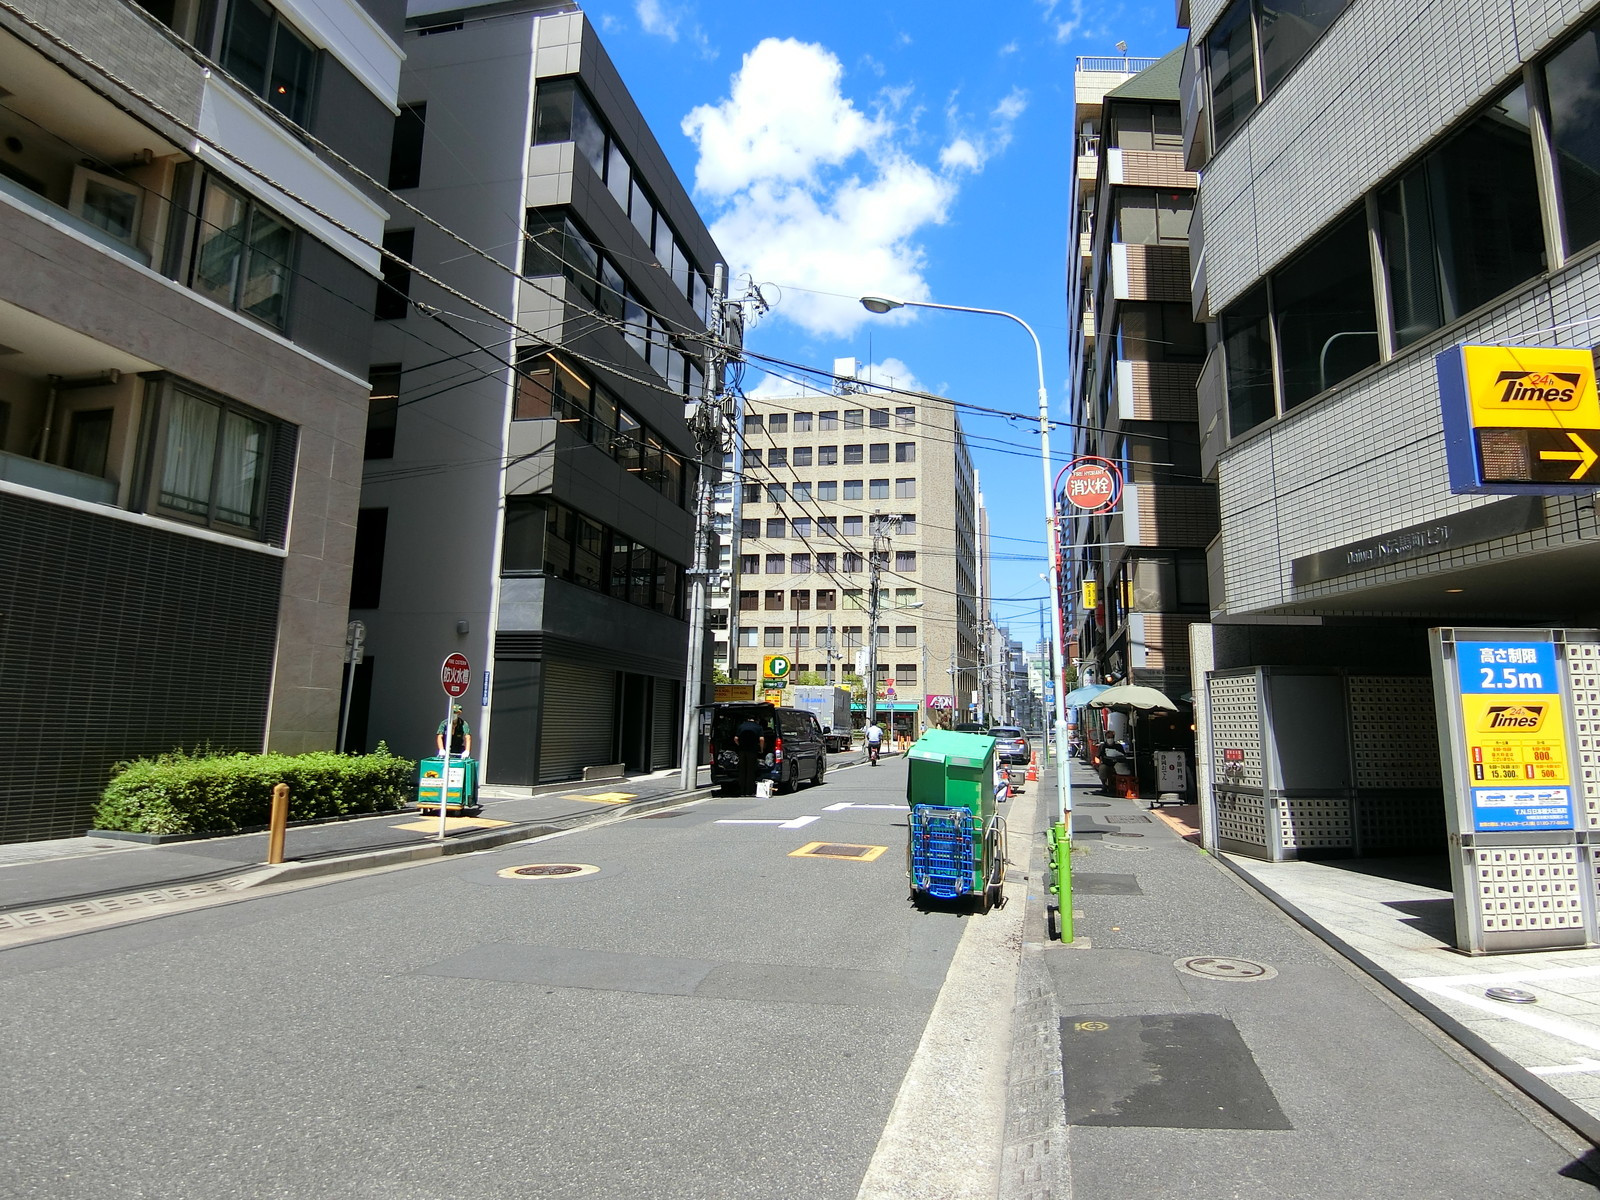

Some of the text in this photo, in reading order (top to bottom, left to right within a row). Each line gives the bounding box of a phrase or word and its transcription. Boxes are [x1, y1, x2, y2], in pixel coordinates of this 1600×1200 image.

[1495, 371, 1575, 402] Times
[1531, 374, 1554, 386] 24h
[1070, 477, 1109, 496] 消火栓
[1480, 648, 1537, 663] 高さ制限
[443, 666, 469, 684] 防火水槽
[774, 659, 786, 674] P
[1480, 668, 1542, 689] 2.5m
[1486, 707, 1539, 728] Times
